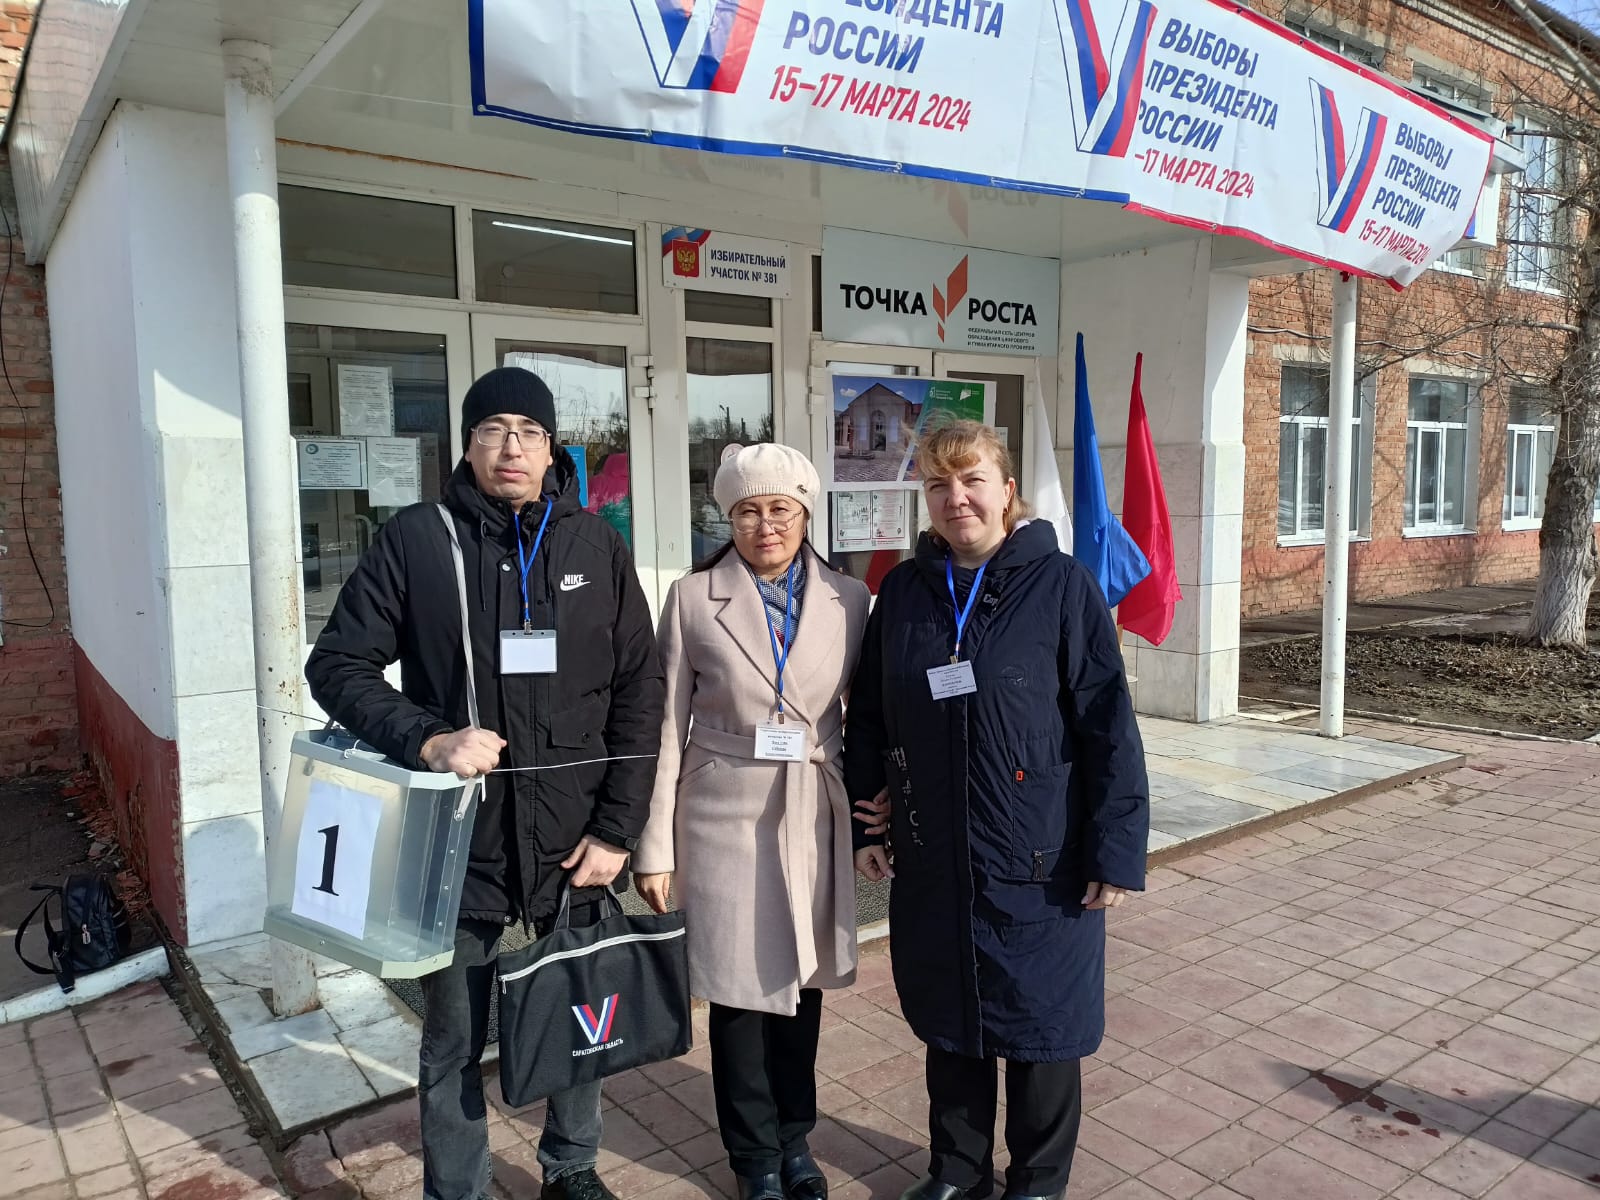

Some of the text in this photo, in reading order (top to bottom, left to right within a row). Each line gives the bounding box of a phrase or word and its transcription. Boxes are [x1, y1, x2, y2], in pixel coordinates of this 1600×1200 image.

[783, 10, 925, 73] РОССИИ
[1158, 18, 1259, 78] ВЫБОРЫ
[769, 65, 972, 132] 15–17 МАРТА 2024
[1145, 59, 1279, 131] ПРЕЗИДЕНТА
[1394, 122, 1453, 170] ВЫБОРЫ
[1158, 153, 1218, 190] МАРТА
[1215, 168, 1255, 199] 2024
[1384, 154, 1462, 211] ПРЕЗИДЕНТА
[1371, 186, 1426, 230] РОССИИ
[710, 249, 786, 268] ИЗБИРАТЕЛЬНЫЙ
[1358, 218, 1391, 246] 15–17
[1383, 230, 1417, 257] МАРТА
[711, 266, 777, 284] УЧАСТОК № 381
[840, 283, 1037, 326] ТОЧКА РОСТА
[564, 574, 584, 585] NIKE
[311, 824, 340, 897] 1
